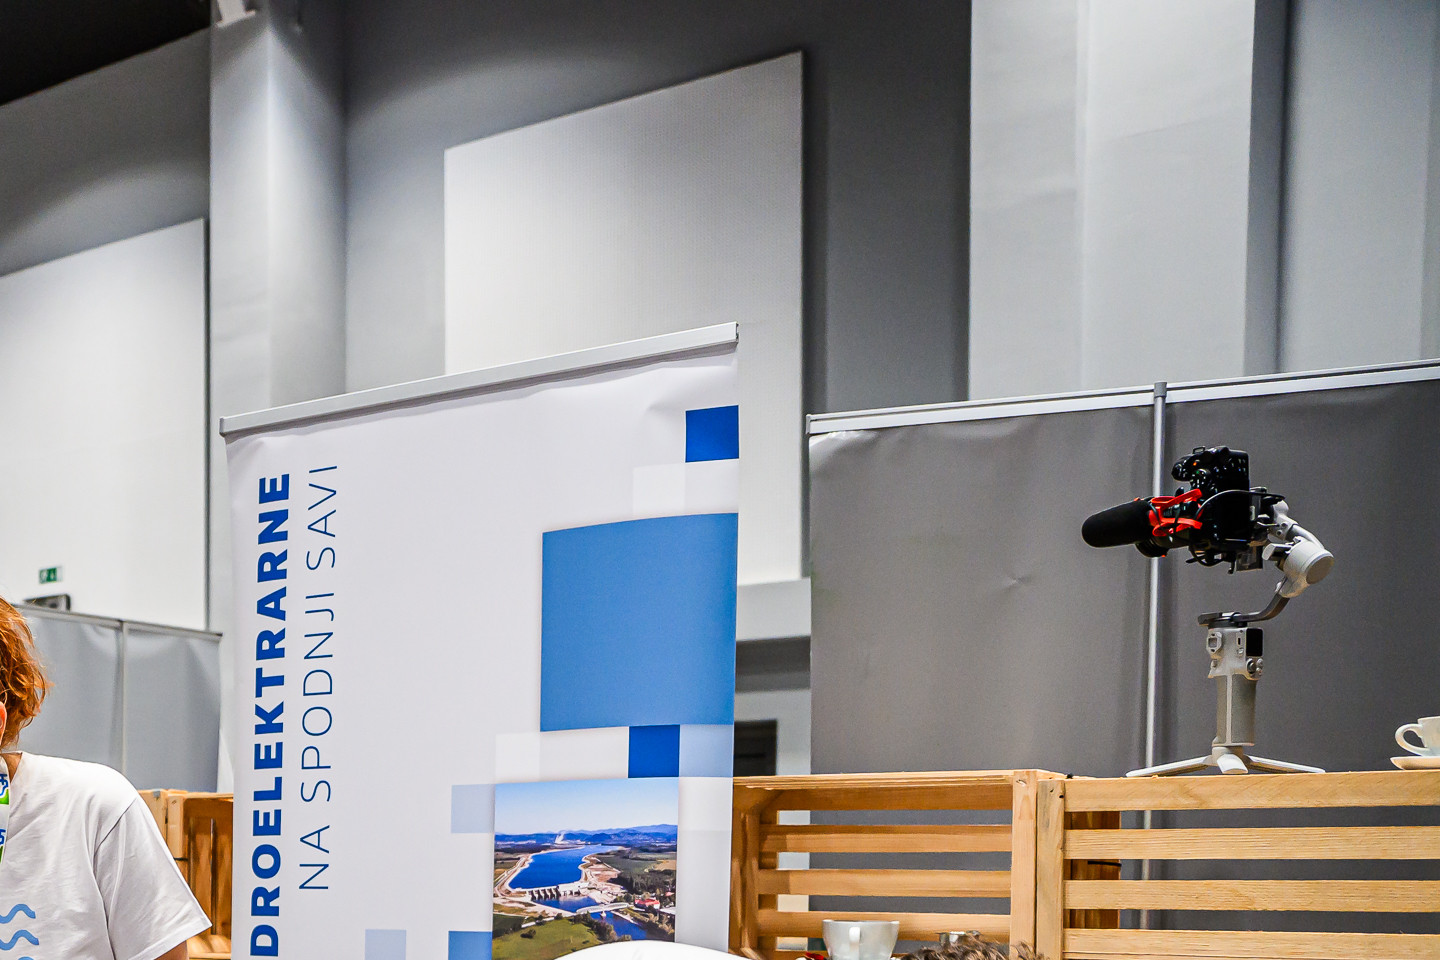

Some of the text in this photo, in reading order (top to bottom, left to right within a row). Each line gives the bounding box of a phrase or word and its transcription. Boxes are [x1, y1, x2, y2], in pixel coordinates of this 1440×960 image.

[299, 465, 339, 891] NA SPODNJI SAVI
